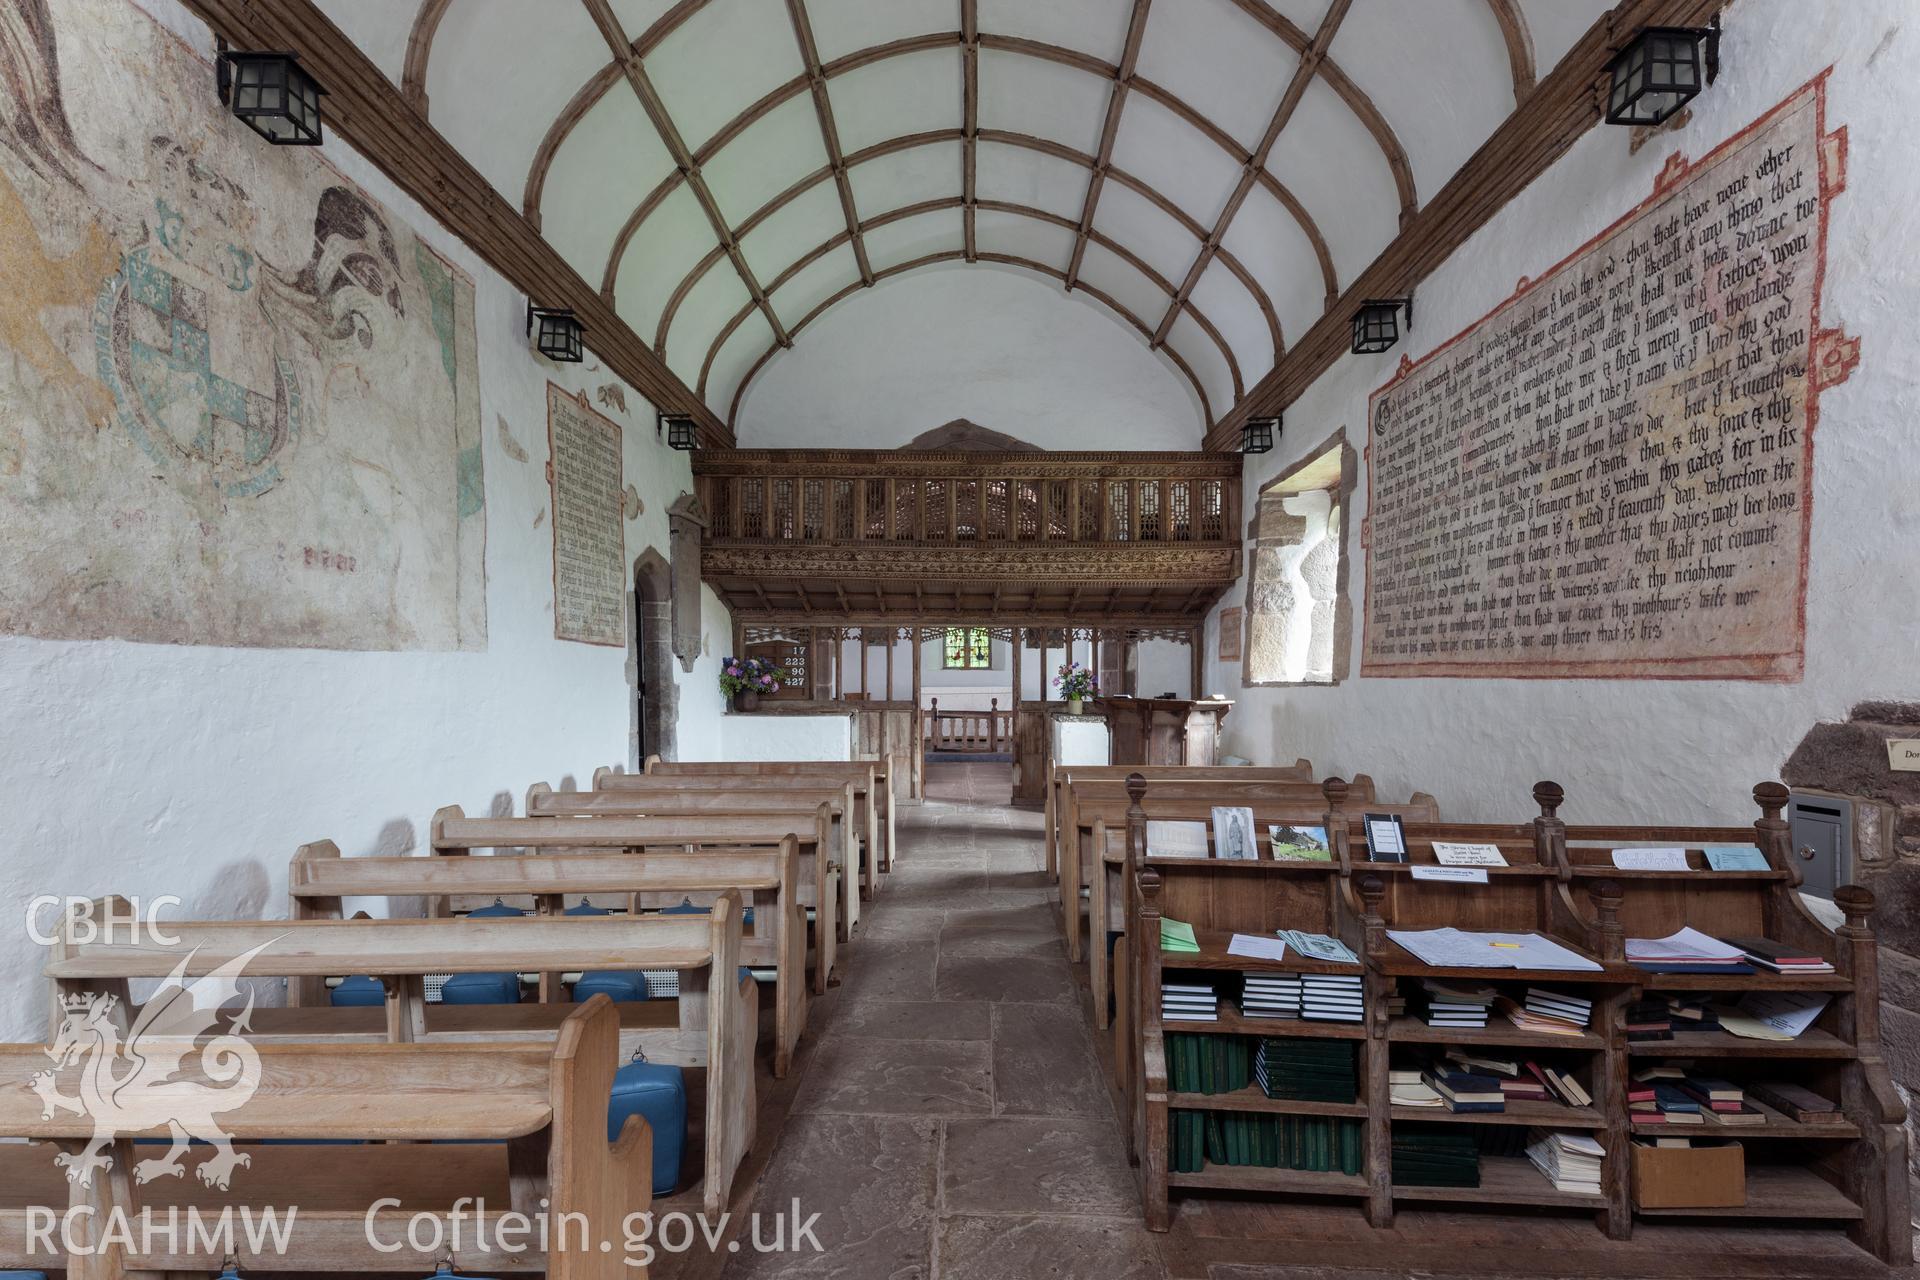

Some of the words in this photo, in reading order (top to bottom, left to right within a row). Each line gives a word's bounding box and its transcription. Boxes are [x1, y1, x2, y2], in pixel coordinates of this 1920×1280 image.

[1755, 145, 1793, 179] other
[1771, 169, 1802, 203] that
[1732, 437, 1754, 461] for
[793, 646, 806, 655] 17
[785, 657, 806, 666] 223
[791, 667, 805, 676] 90
[784, 677, 805, 686] 427
